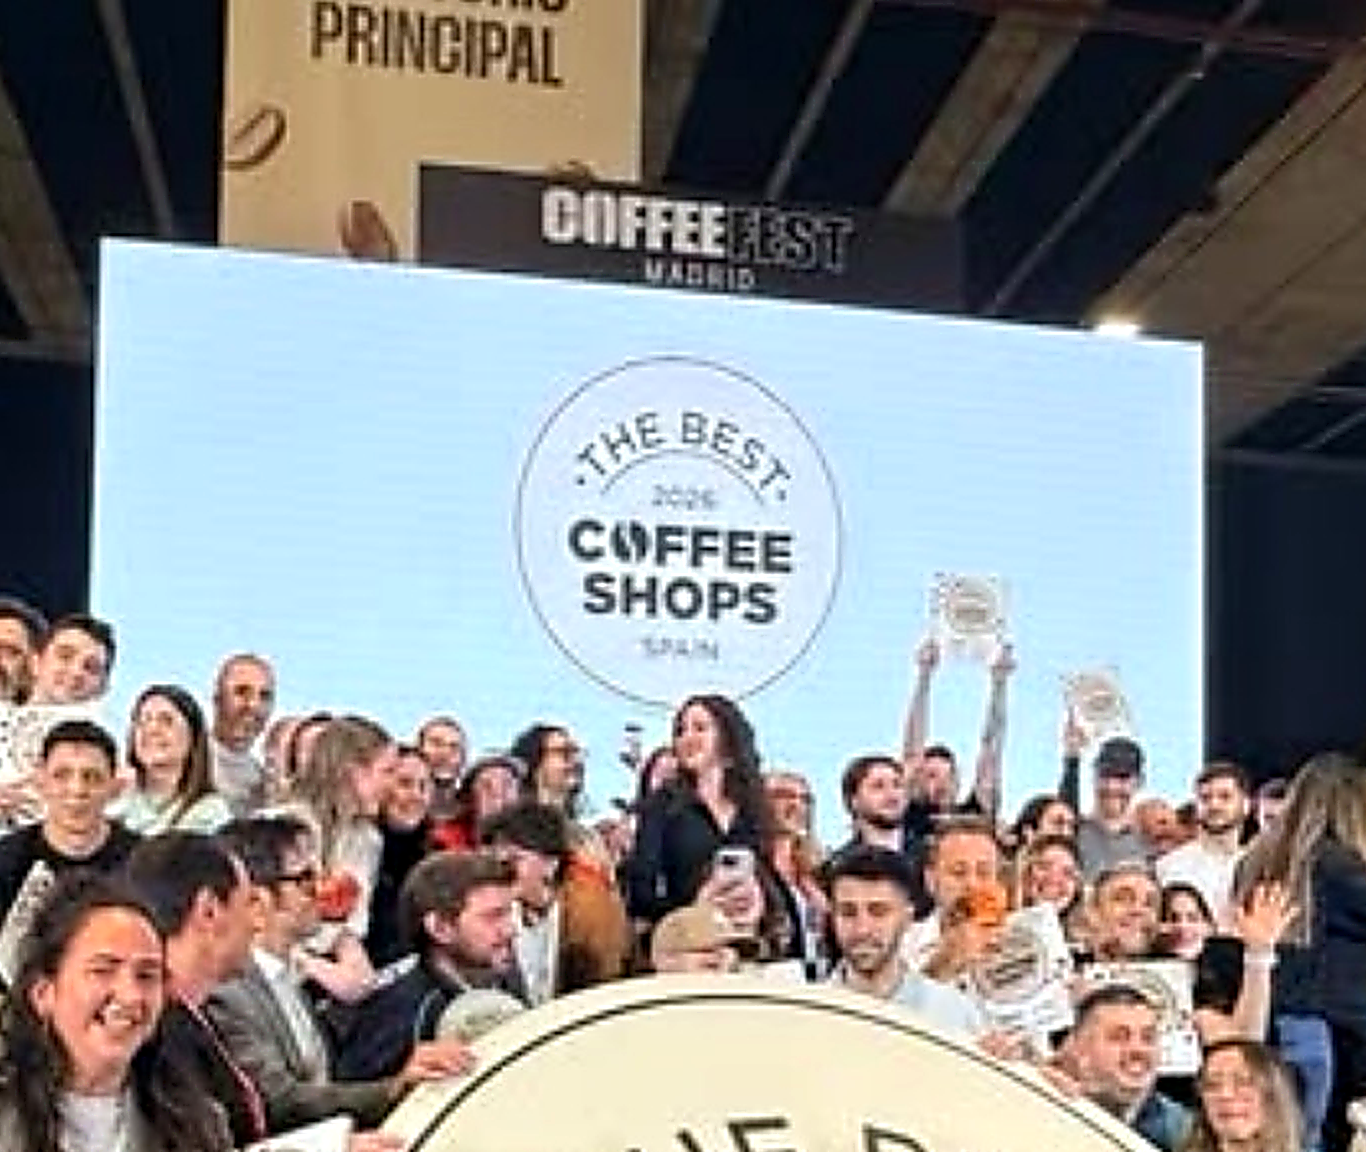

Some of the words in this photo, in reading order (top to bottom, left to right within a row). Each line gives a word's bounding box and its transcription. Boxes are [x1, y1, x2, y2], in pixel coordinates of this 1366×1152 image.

[309, 2, 564, 88] PRINCIPAL
[645, 258, 755, 291] MADRID
[576, 411, 666, 477] THE
[681, 410, 792, 490] BEST
[567, 518, 793, 575] COFFEE
[583, 571, 777, 625] SHOPS
